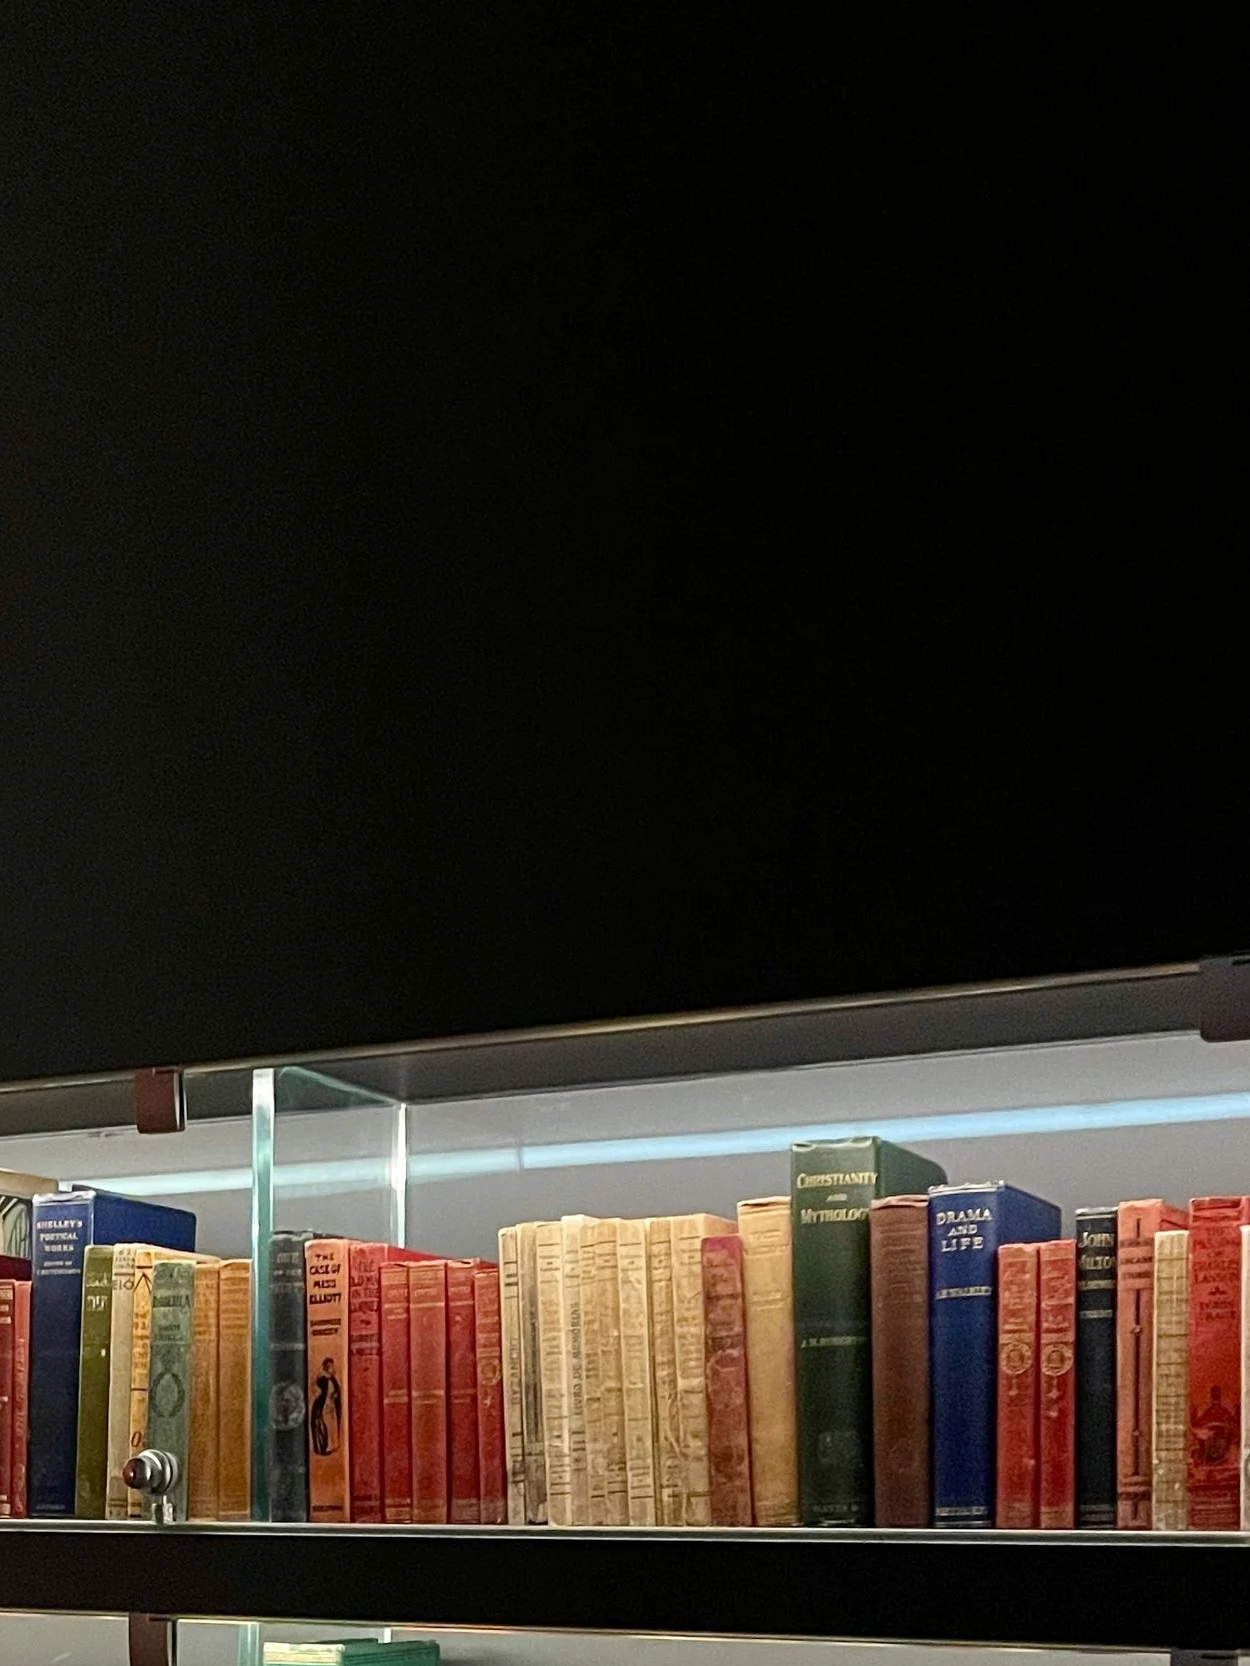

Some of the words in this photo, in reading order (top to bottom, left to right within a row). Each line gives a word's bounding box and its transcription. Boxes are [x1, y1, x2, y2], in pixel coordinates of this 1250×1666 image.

[797, 1172, 878, 1189] CHRISTIANITY
[801, 1207, 871, 1224] MYTHOLOG
[936, 1208, 993, 1226] DRAMA
[947, 1225, 979, 1237] AND
[941, 1237, 984, 1252] LIFE
[315, 1252, 335, 1260] THE
[310, 1265, 331, 1275] CASE
[313, 1279, 337, 1289] MISS
[309, 1292, 342, 1305] ELLIOTT
[571, 1365, 582, 1381] DE
[571, 1383, 583, 1416] LIVRO
